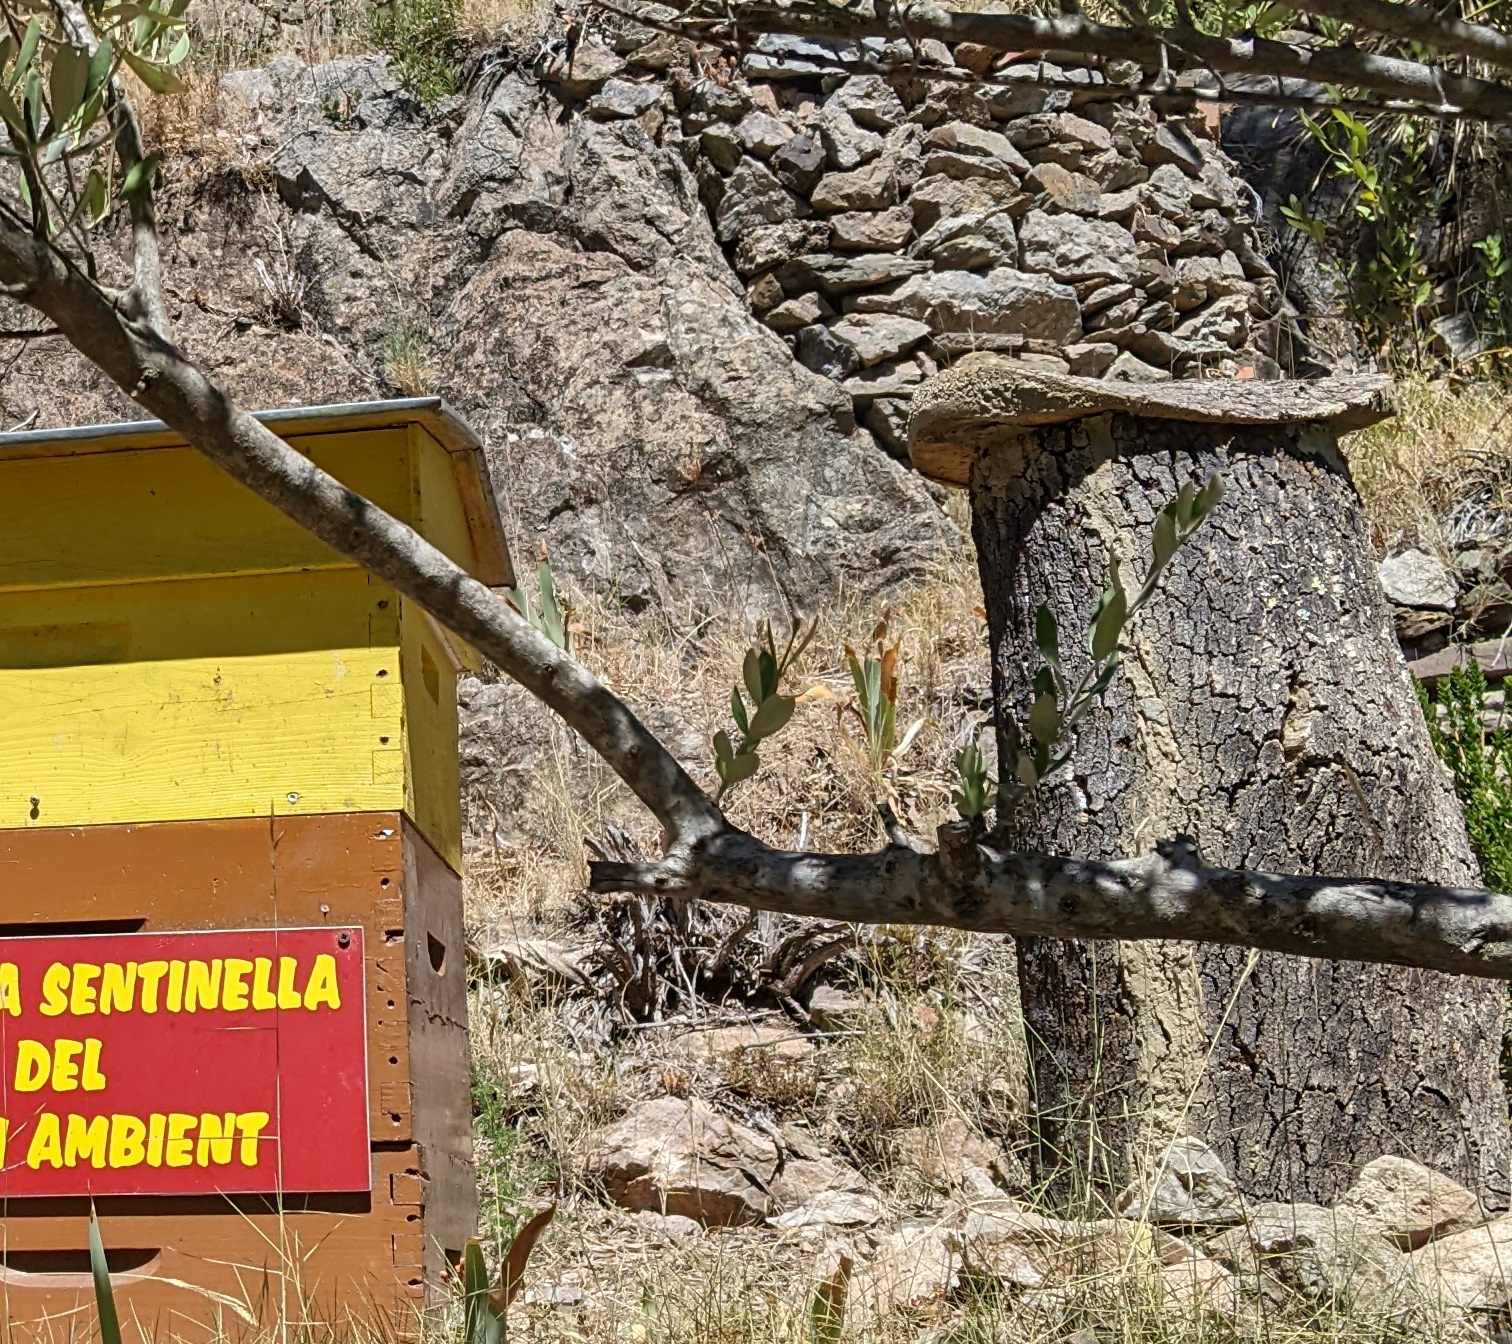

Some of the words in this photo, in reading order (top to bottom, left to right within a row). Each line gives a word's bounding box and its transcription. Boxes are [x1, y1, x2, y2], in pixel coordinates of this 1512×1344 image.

[39, 954, 342, 1017] SENTINELLA
[14, 1039, 107, 1093] DEL
[26, 1111, 270, 1170] AMBIENT
